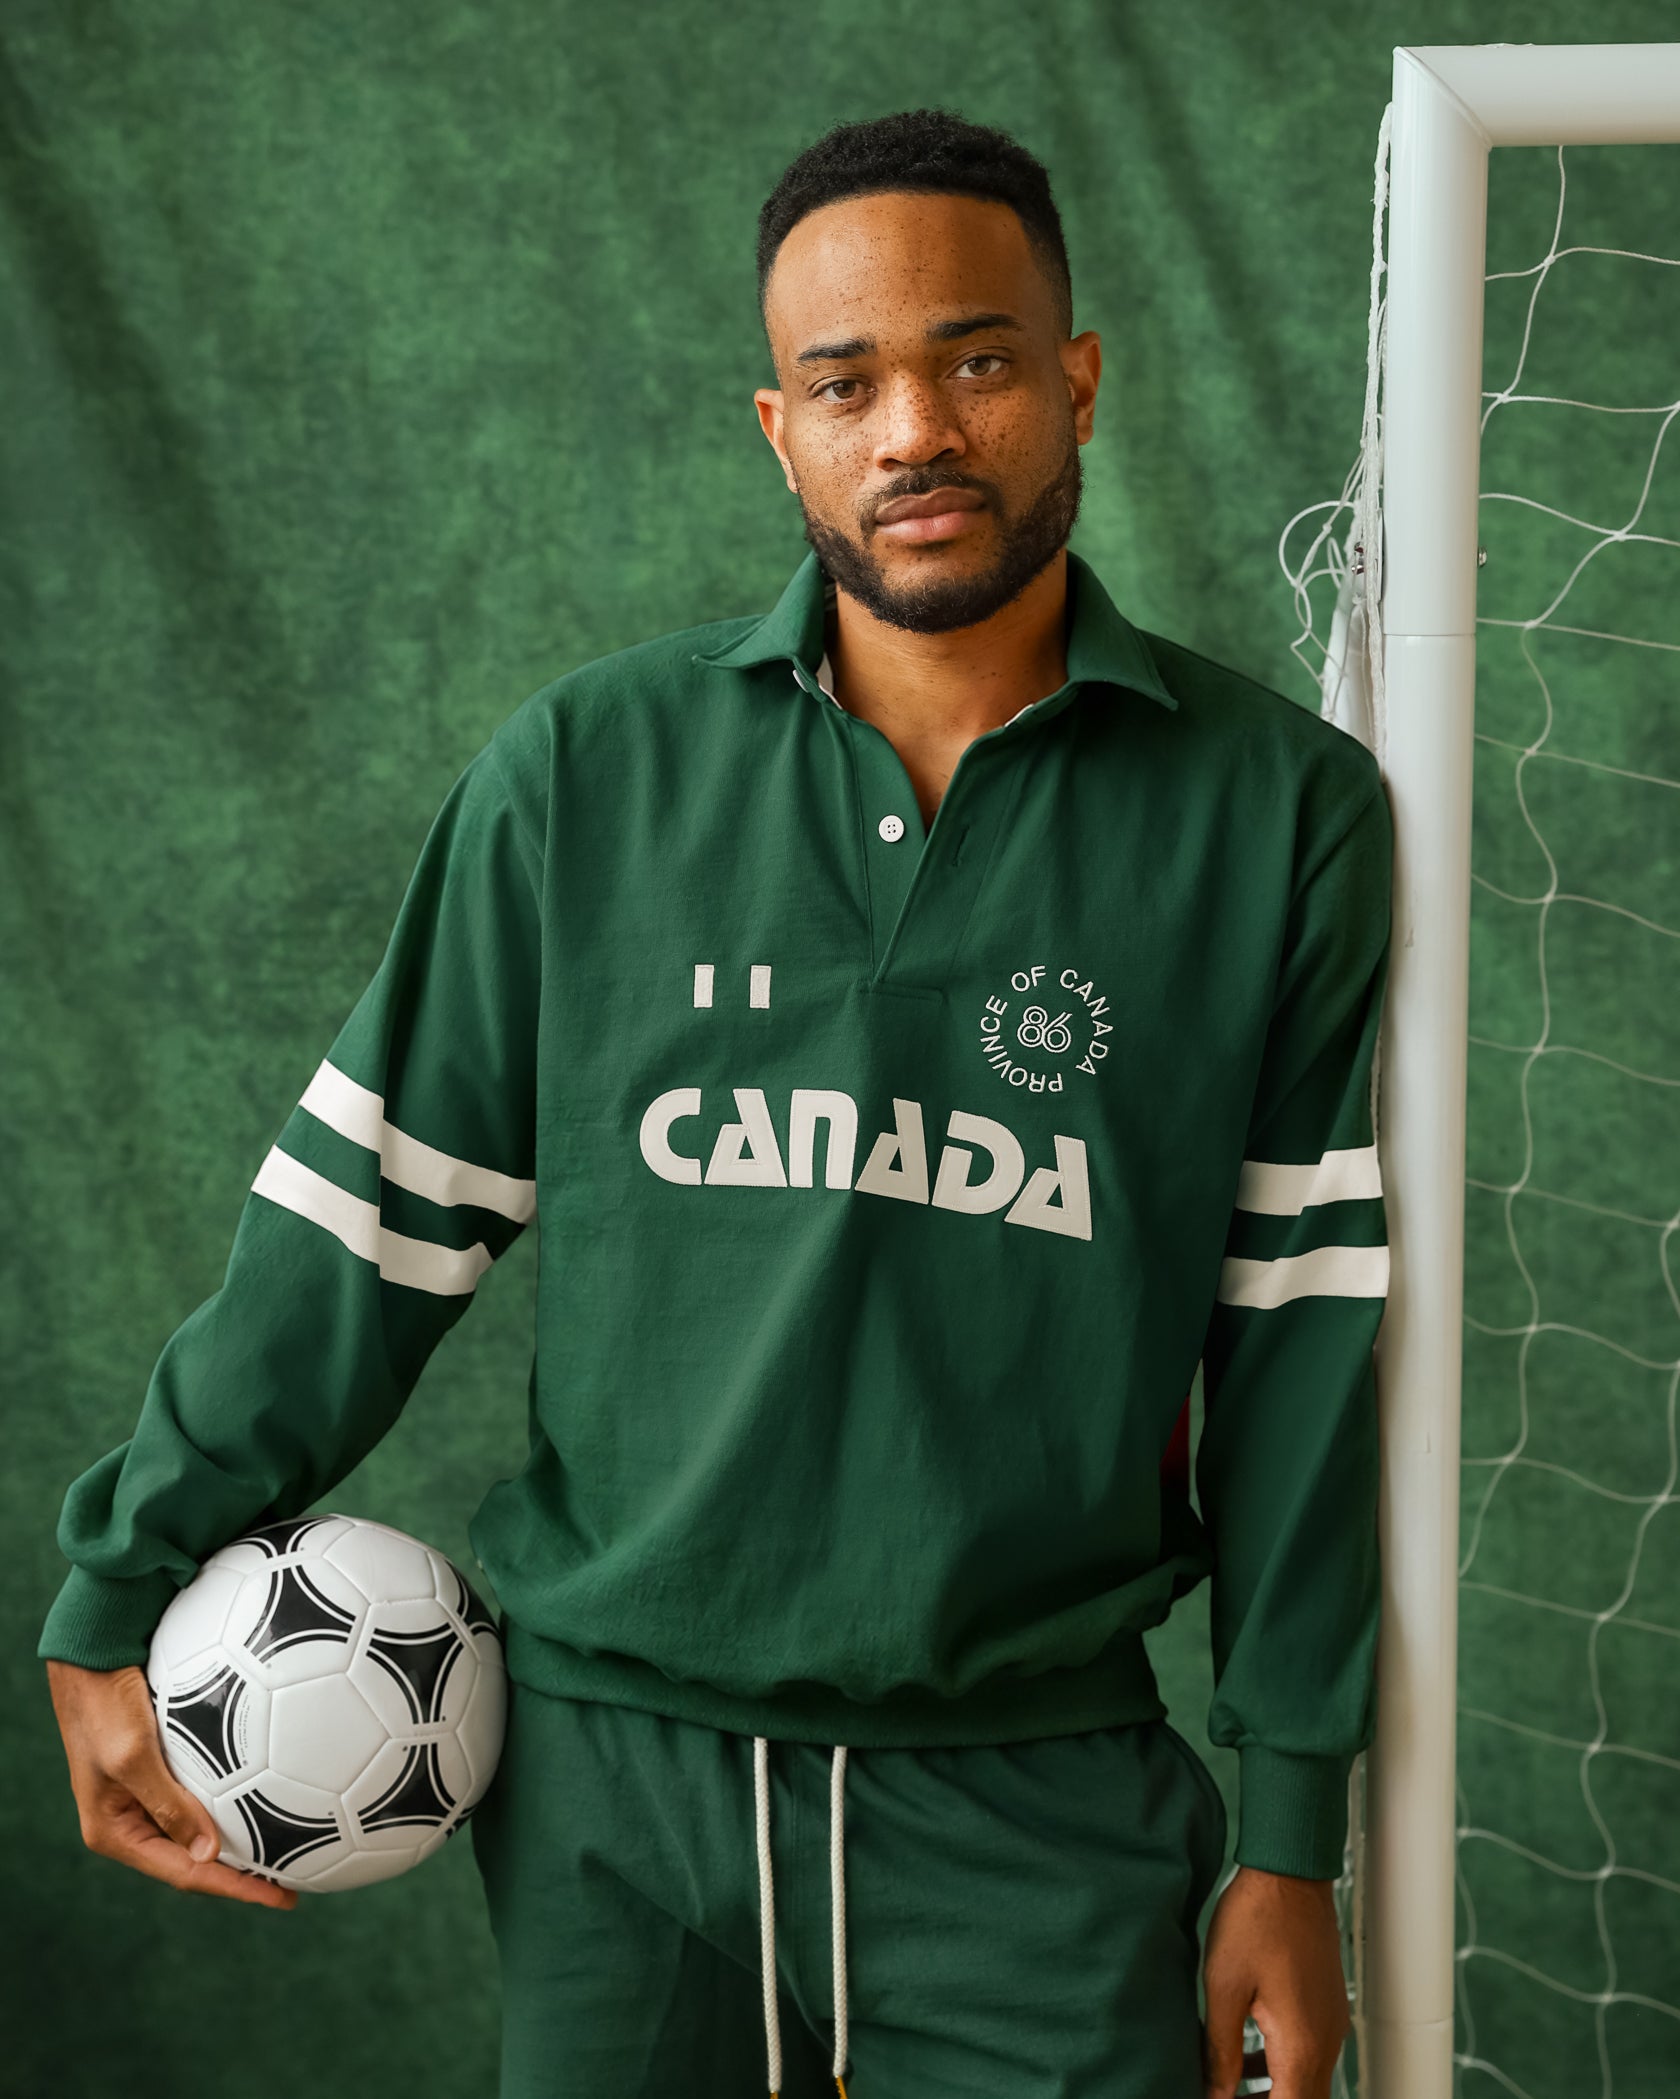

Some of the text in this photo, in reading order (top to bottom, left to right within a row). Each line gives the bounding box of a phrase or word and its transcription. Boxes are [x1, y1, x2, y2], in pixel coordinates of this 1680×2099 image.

[980, 965, 1114, 1093] PROVINCE OF CANADA
[1017, 1005, 1073, 1053] 86
[639, 1087, 1093, 1241] CANADA
